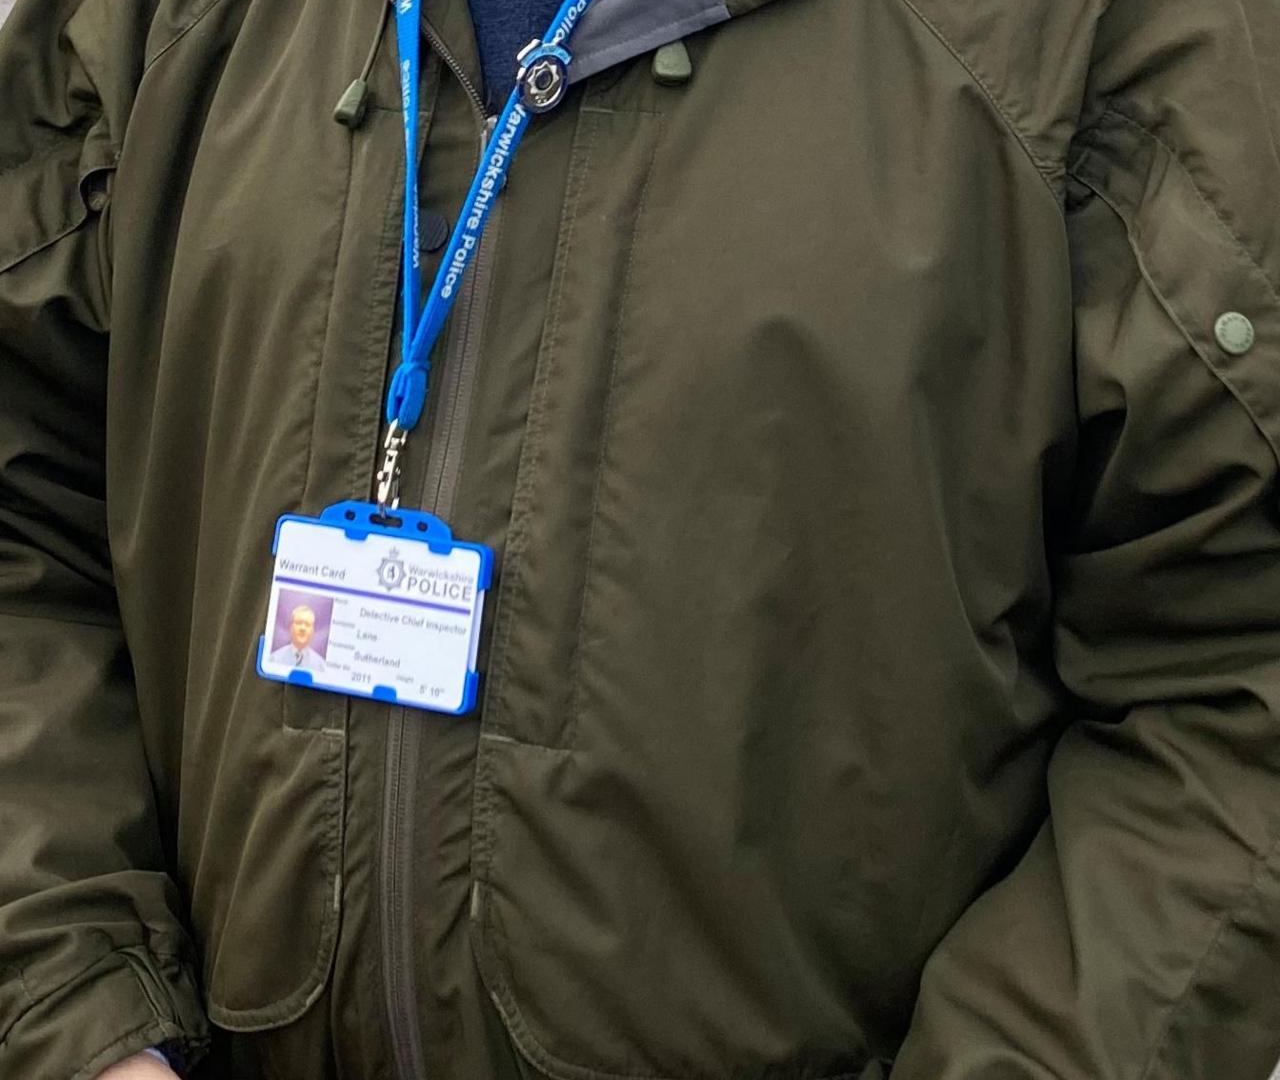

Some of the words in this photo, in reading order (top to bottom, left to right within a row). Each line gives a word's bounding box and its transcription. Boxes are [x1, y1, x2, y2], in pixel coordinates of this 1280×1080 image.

[441, 234, 476, 299] Police
[280, 559, 318, 576] Warrant
[321, 565, 346, 580] Card
[407, 576, 472, 602] POLICE
[402, 615, 424, 627] Chief
